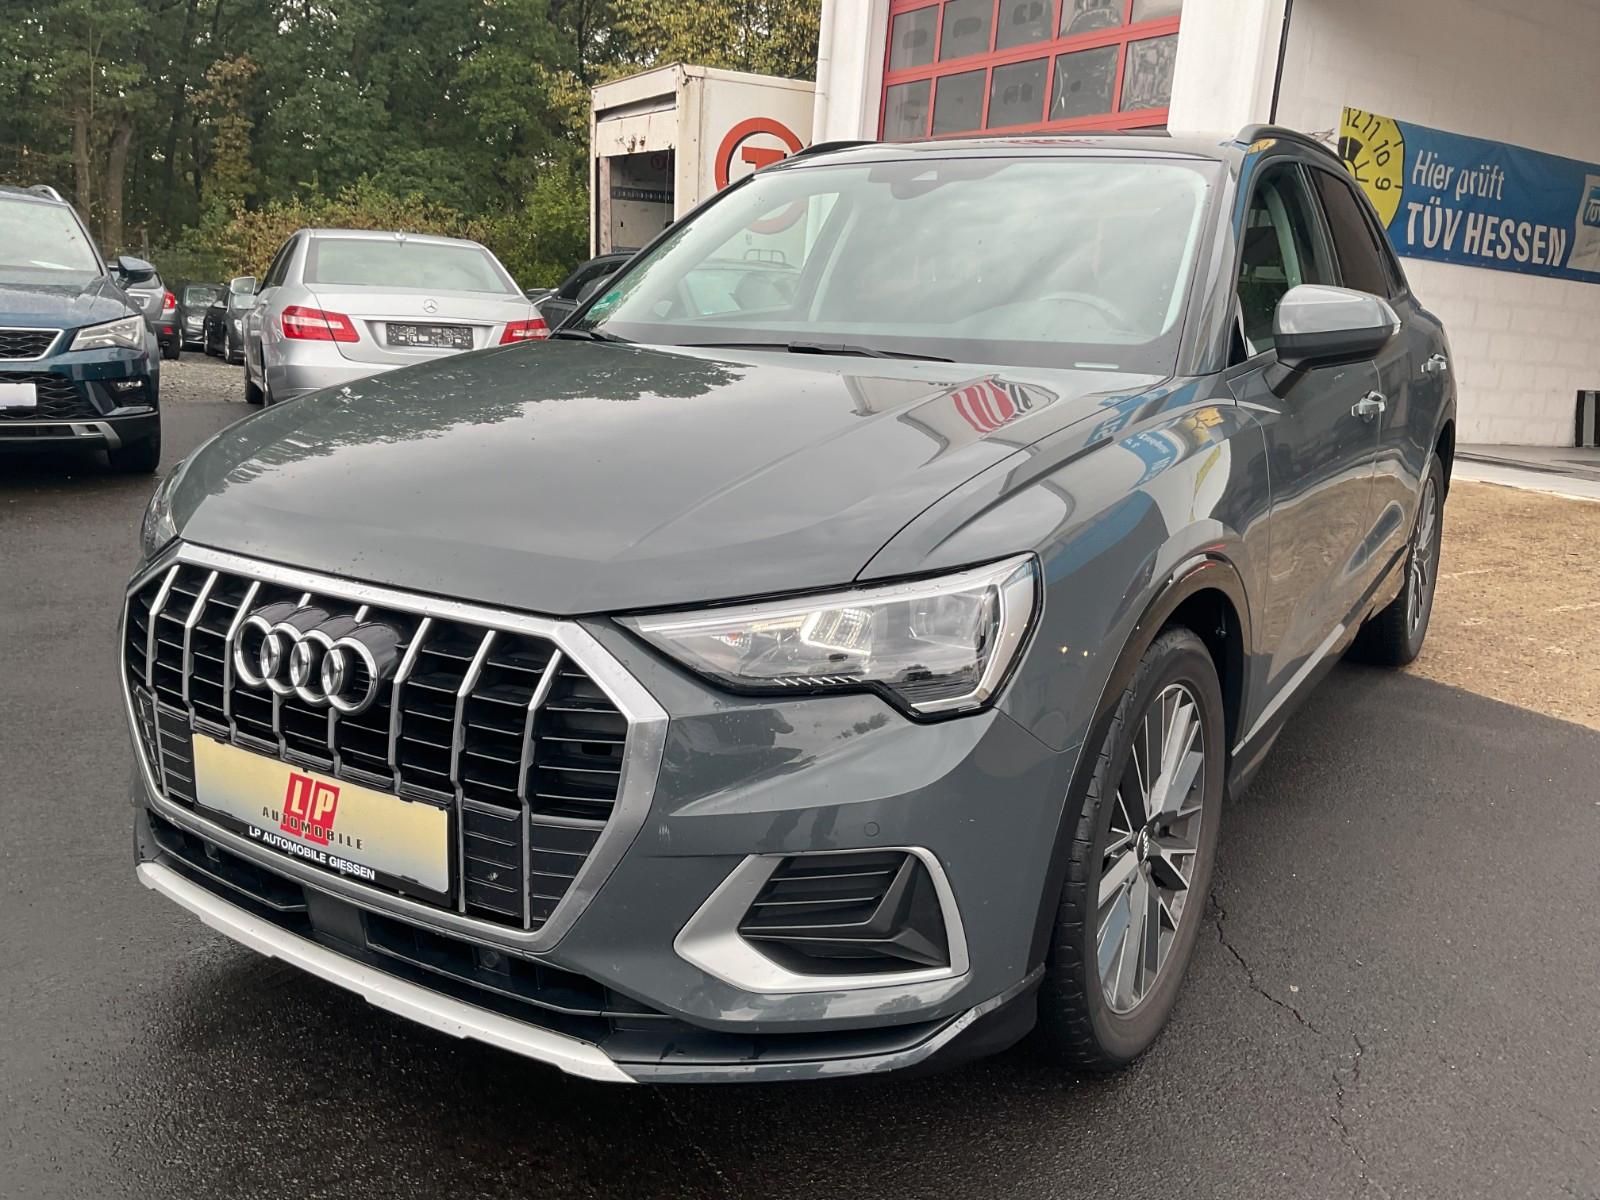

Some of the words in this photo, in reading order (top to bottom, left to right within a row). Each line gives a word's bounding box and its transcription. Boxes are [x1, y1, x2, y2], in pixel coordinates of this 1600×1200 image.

[1346, 108, 1362, 129] 12
[1362, 114, 1381, 142] 11
[1373, 140, 1390, 167] 10
[1412, 149, 1454, 191] Hier
[1455, 164, 1505, 201] prüft
[1407, 196, 1462, 251] TÜV
[1463, 212, 1567, 267] HESSEN
[262, 806, 364, 851] AUTOMOBILE
[249, 825, 262, 838] LP
[262, 830, 326, 864] AUTOMOBILE
[329, 856, 376, 881] GIESSEN
